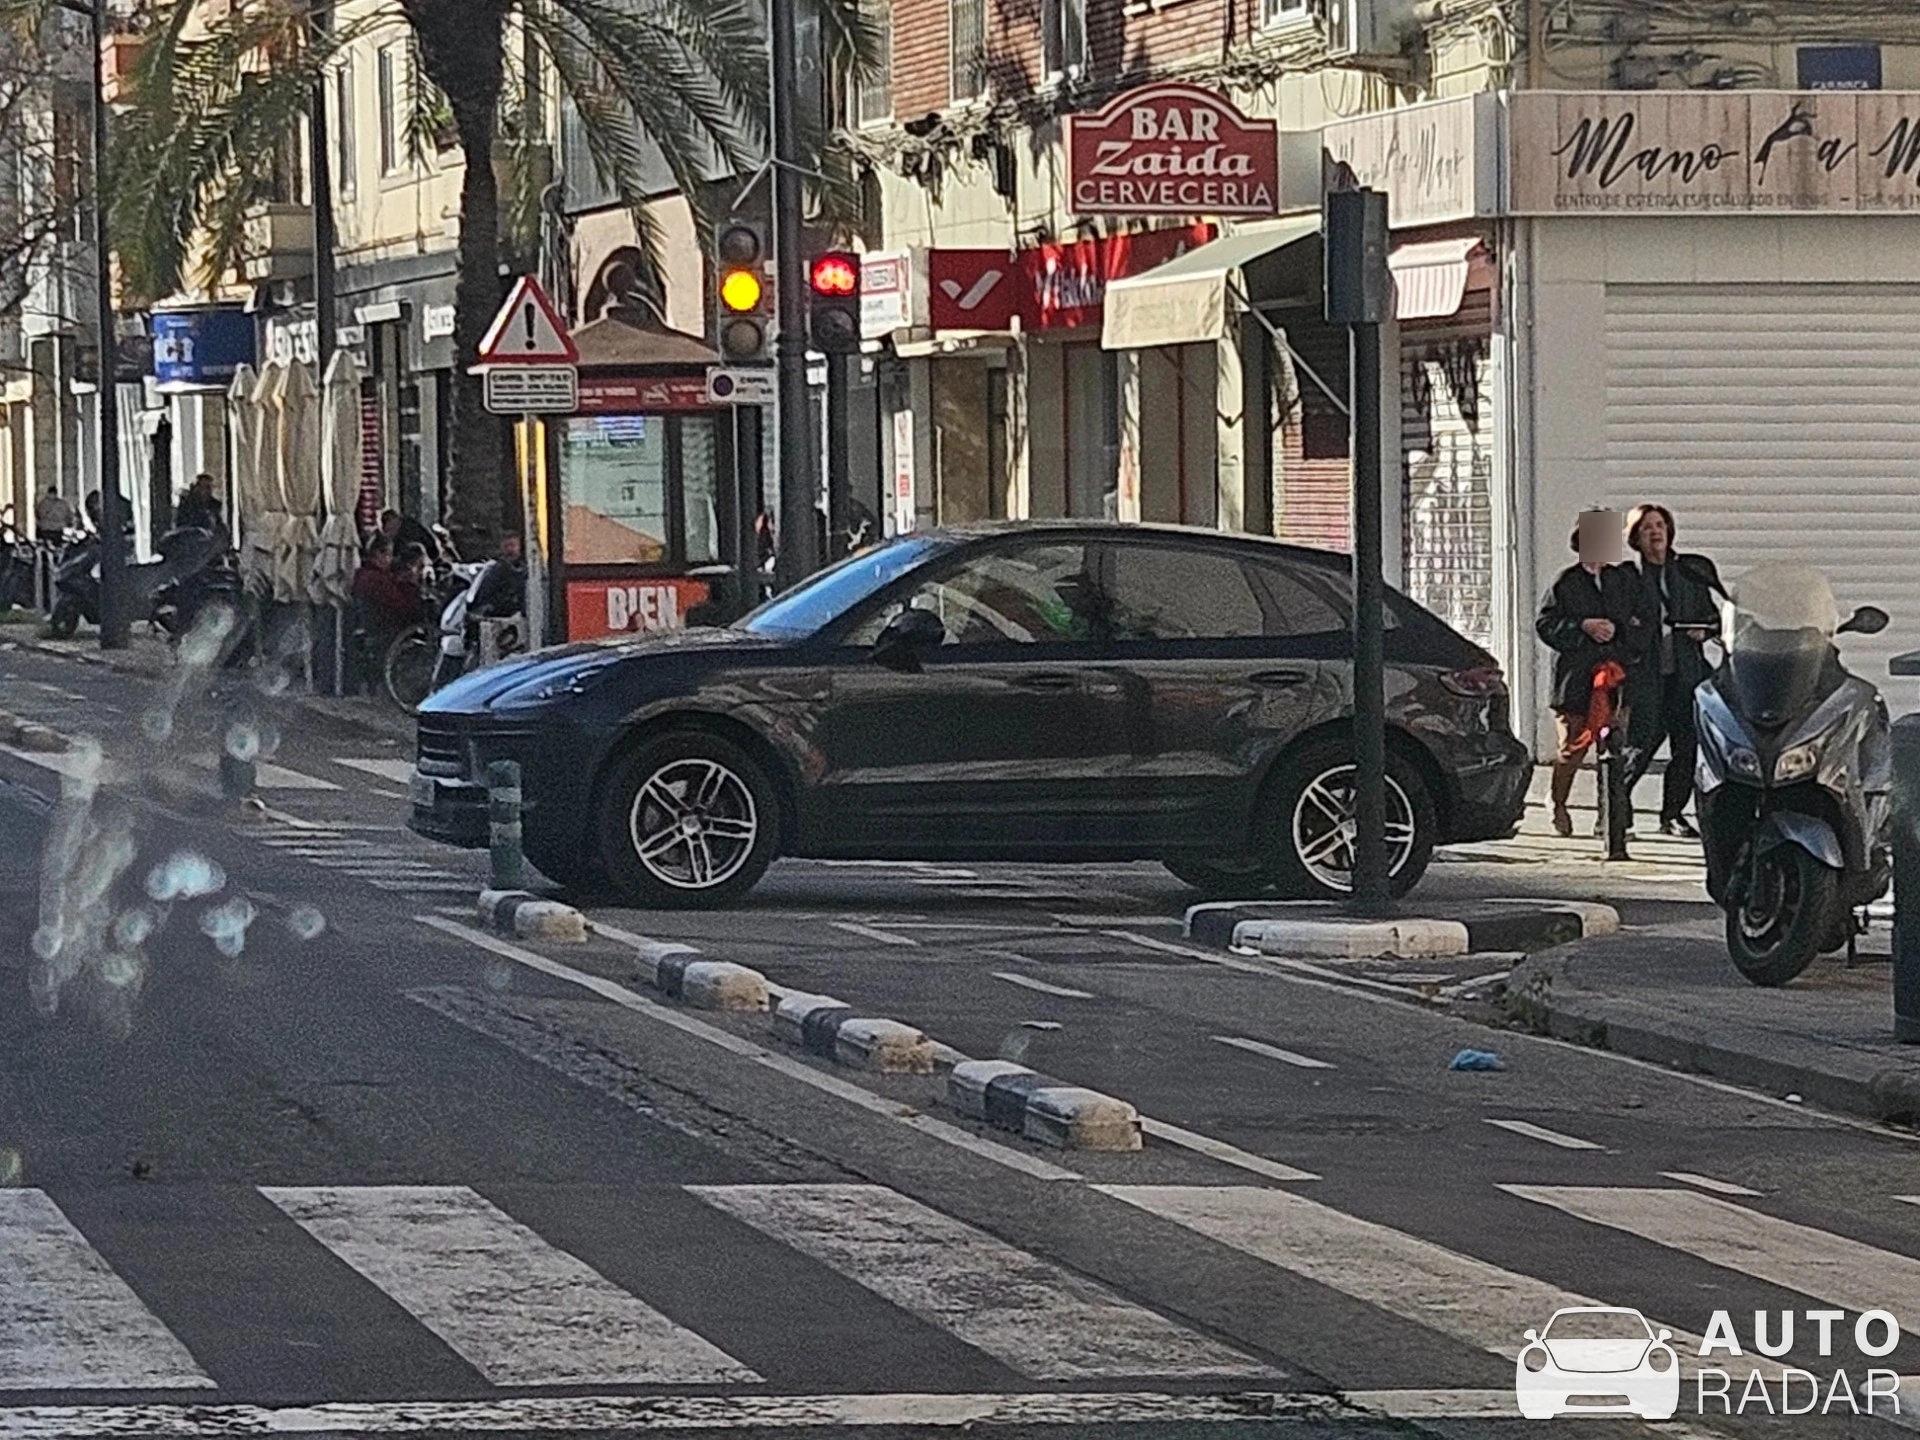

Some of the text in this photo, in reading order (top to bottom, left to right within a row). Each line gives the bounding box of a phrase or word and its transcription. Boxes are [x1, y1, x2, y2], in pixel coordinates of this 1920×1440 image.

[1130, 107, 1220, 141] BAR
[1089, 141, 1256, 177] Zaida
[1551, 112, 1739, 188] Mano
[1075, 180, 1273, 206] CERVECERIA
[1554, 193, 1601, 209] CENTRO
[607, 586, 678, 630] BIEN
